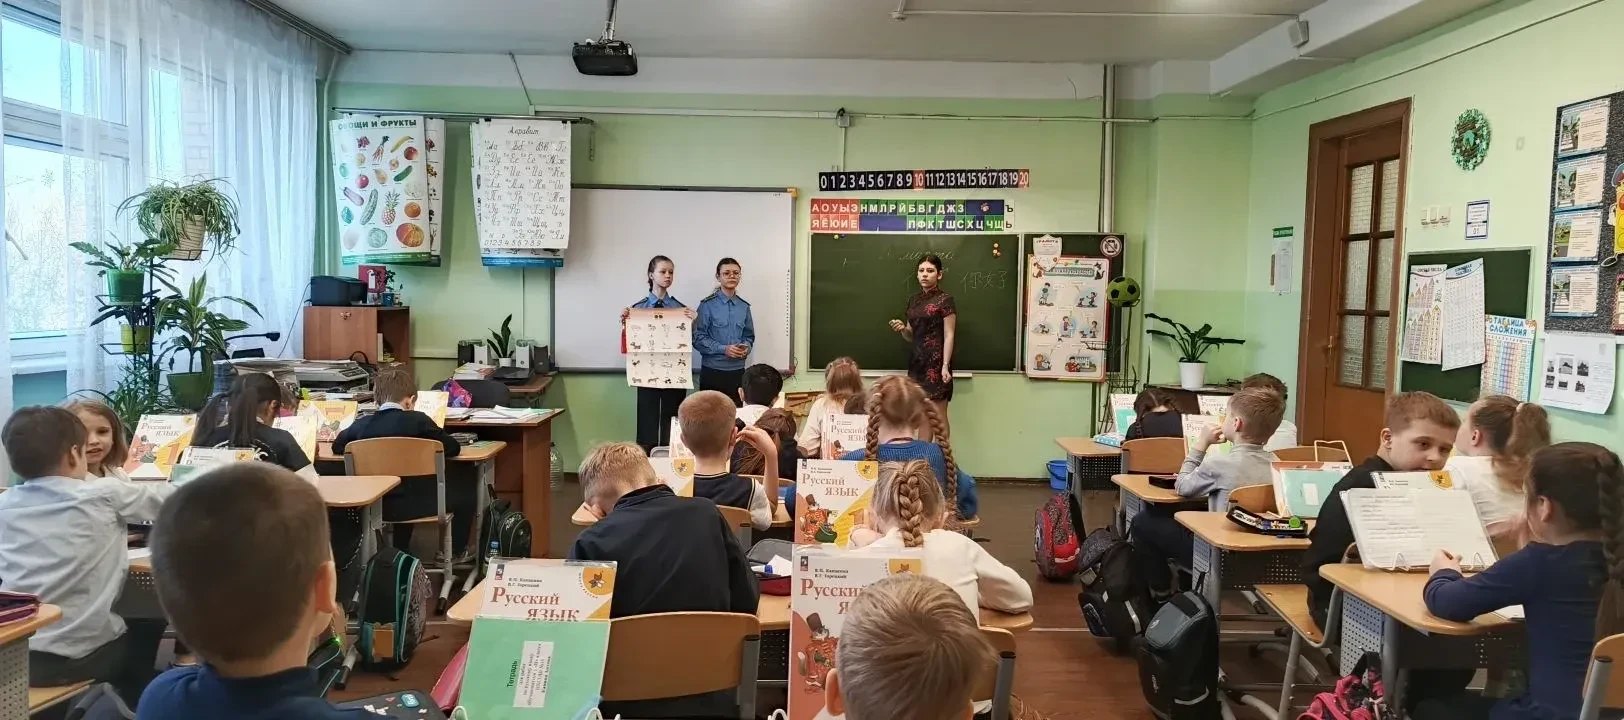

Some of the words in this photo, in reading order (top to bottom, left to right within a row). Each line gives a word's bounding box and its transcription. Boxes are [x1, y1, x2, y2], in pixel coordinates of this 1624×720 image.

[915, 173, 923, 186] 10
[926, 173, 933, 185] 11
[936, 173, 944, 185] 12
[946, 173, 955, 185] 13
[957, 173, 966, 185] 14
[967, 173, 976, 185] 15
[978, 172, 987, 185] 16
[988, 172, 997, 185] 17
[999, 172, 1007, 185] 18
[1009, 172, 1018, 185] 19
[1020, 172, 1028, 185] 20
[1490, 325, 1527, 336] СЛОЖЕНИЯ
[802, 473, 845, 486] Русский
[825, 487, 859, 496] ЯЗЫК
[491, 587, 560, 606] Русский
[526, 609, 579, 622] ЯЗЫК
[507, 661, 517, 687] Тетрадь
